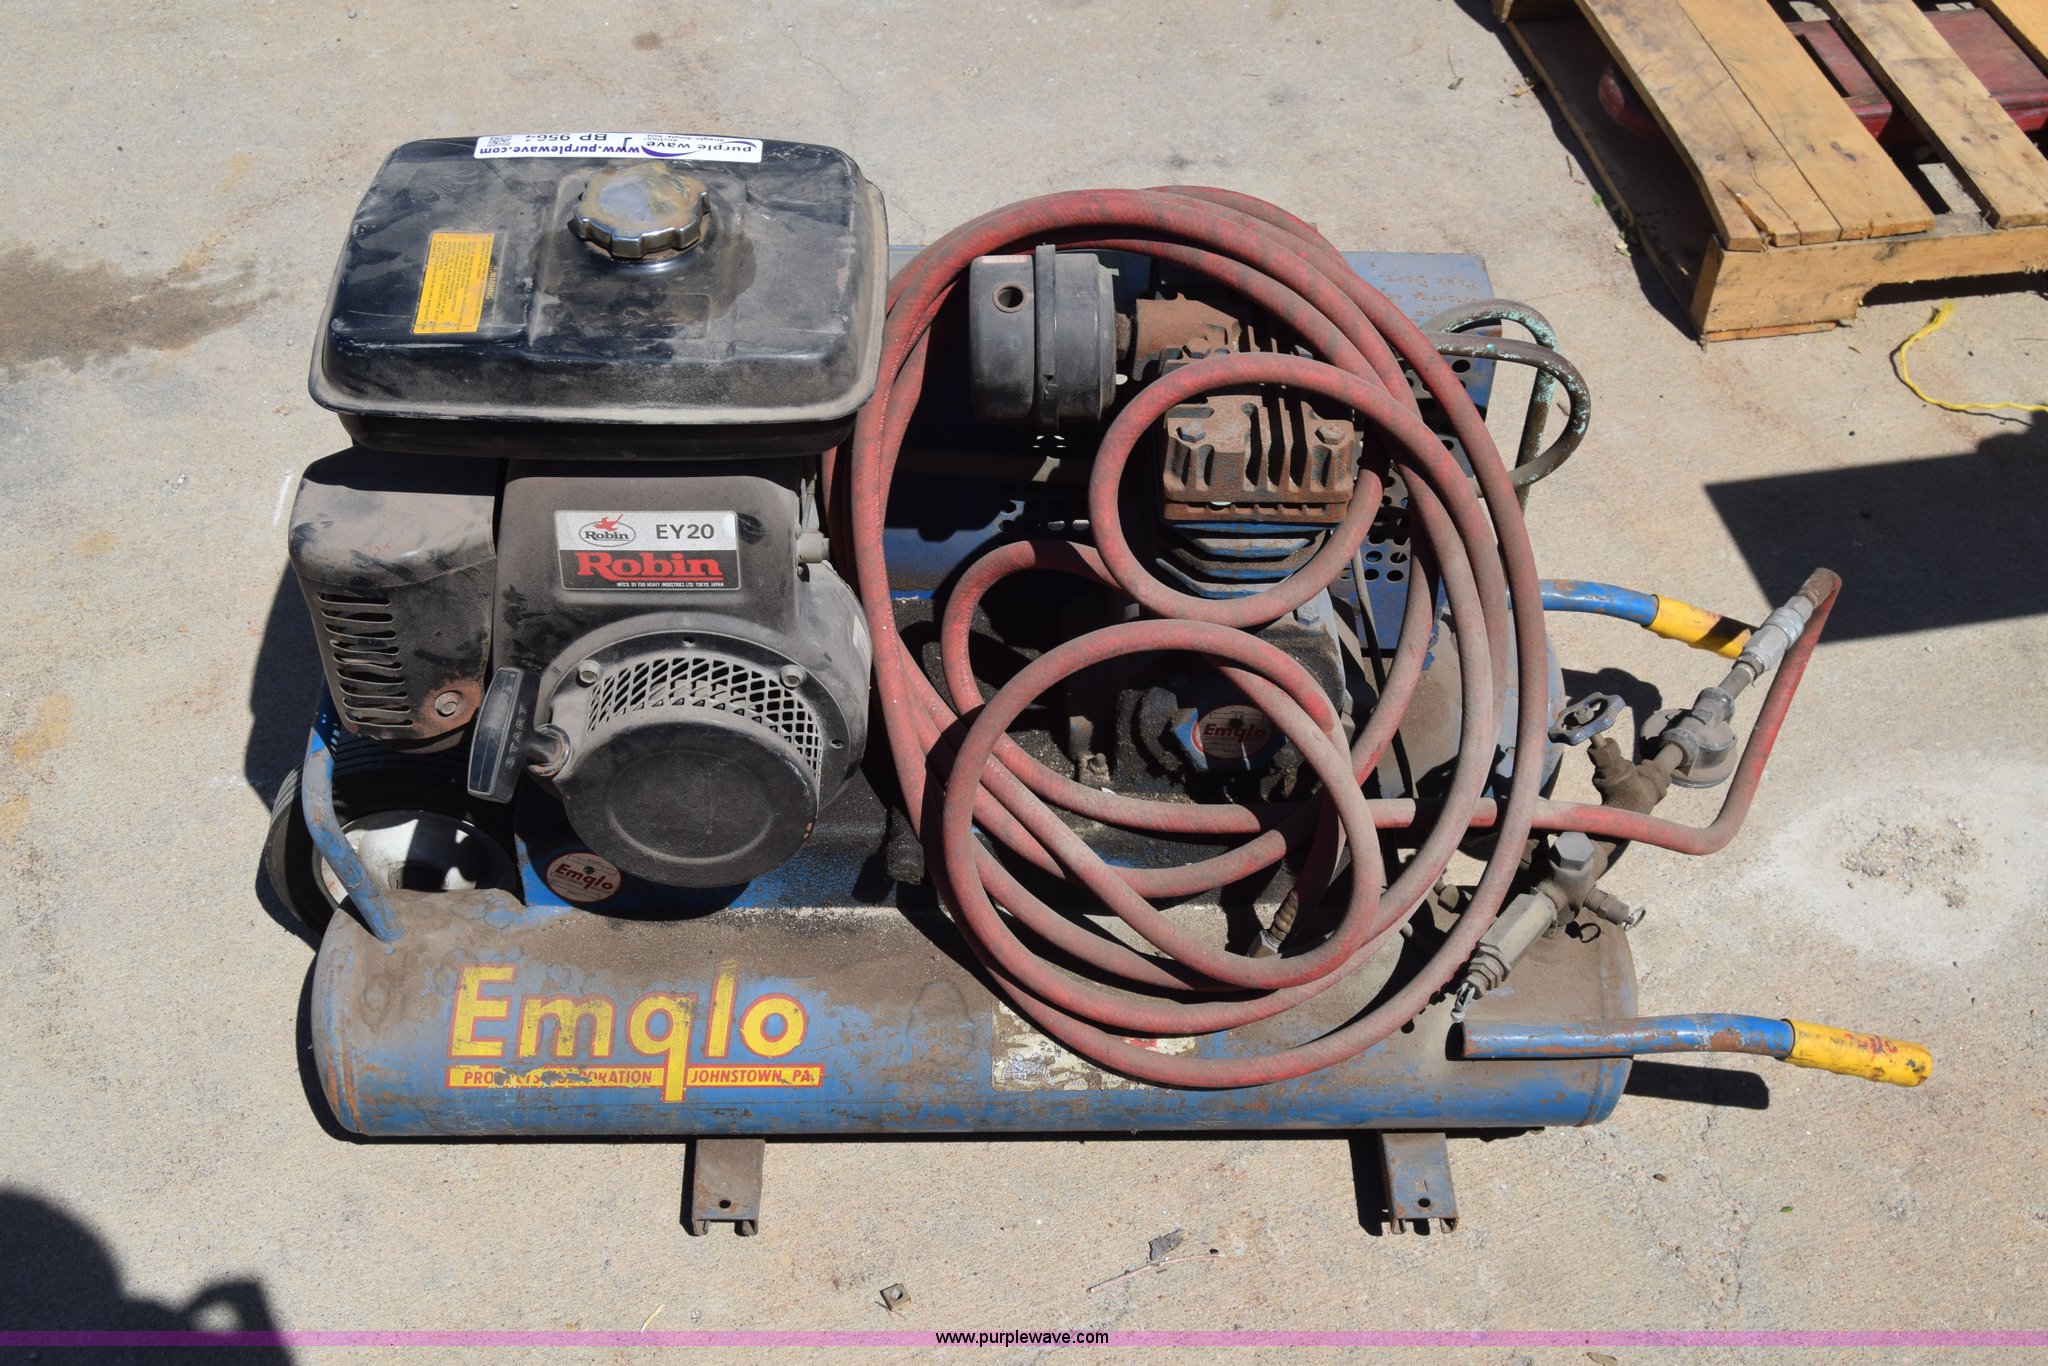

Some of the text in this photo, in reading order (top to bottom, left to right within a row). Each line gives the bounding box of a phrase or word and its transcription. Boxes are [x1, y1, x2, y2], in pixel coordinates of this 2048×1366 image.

[579, 133, 608, 142] BP
[480, 143, 640, 155] www.purplewave.com
[646, 141, 752, 152] purple wave
[585, 530, 630, 542] Robin
[655, 523, 715, 540] EY20
[575, 551, 725, 582] Robin
[506, 704, 528, 769] START
